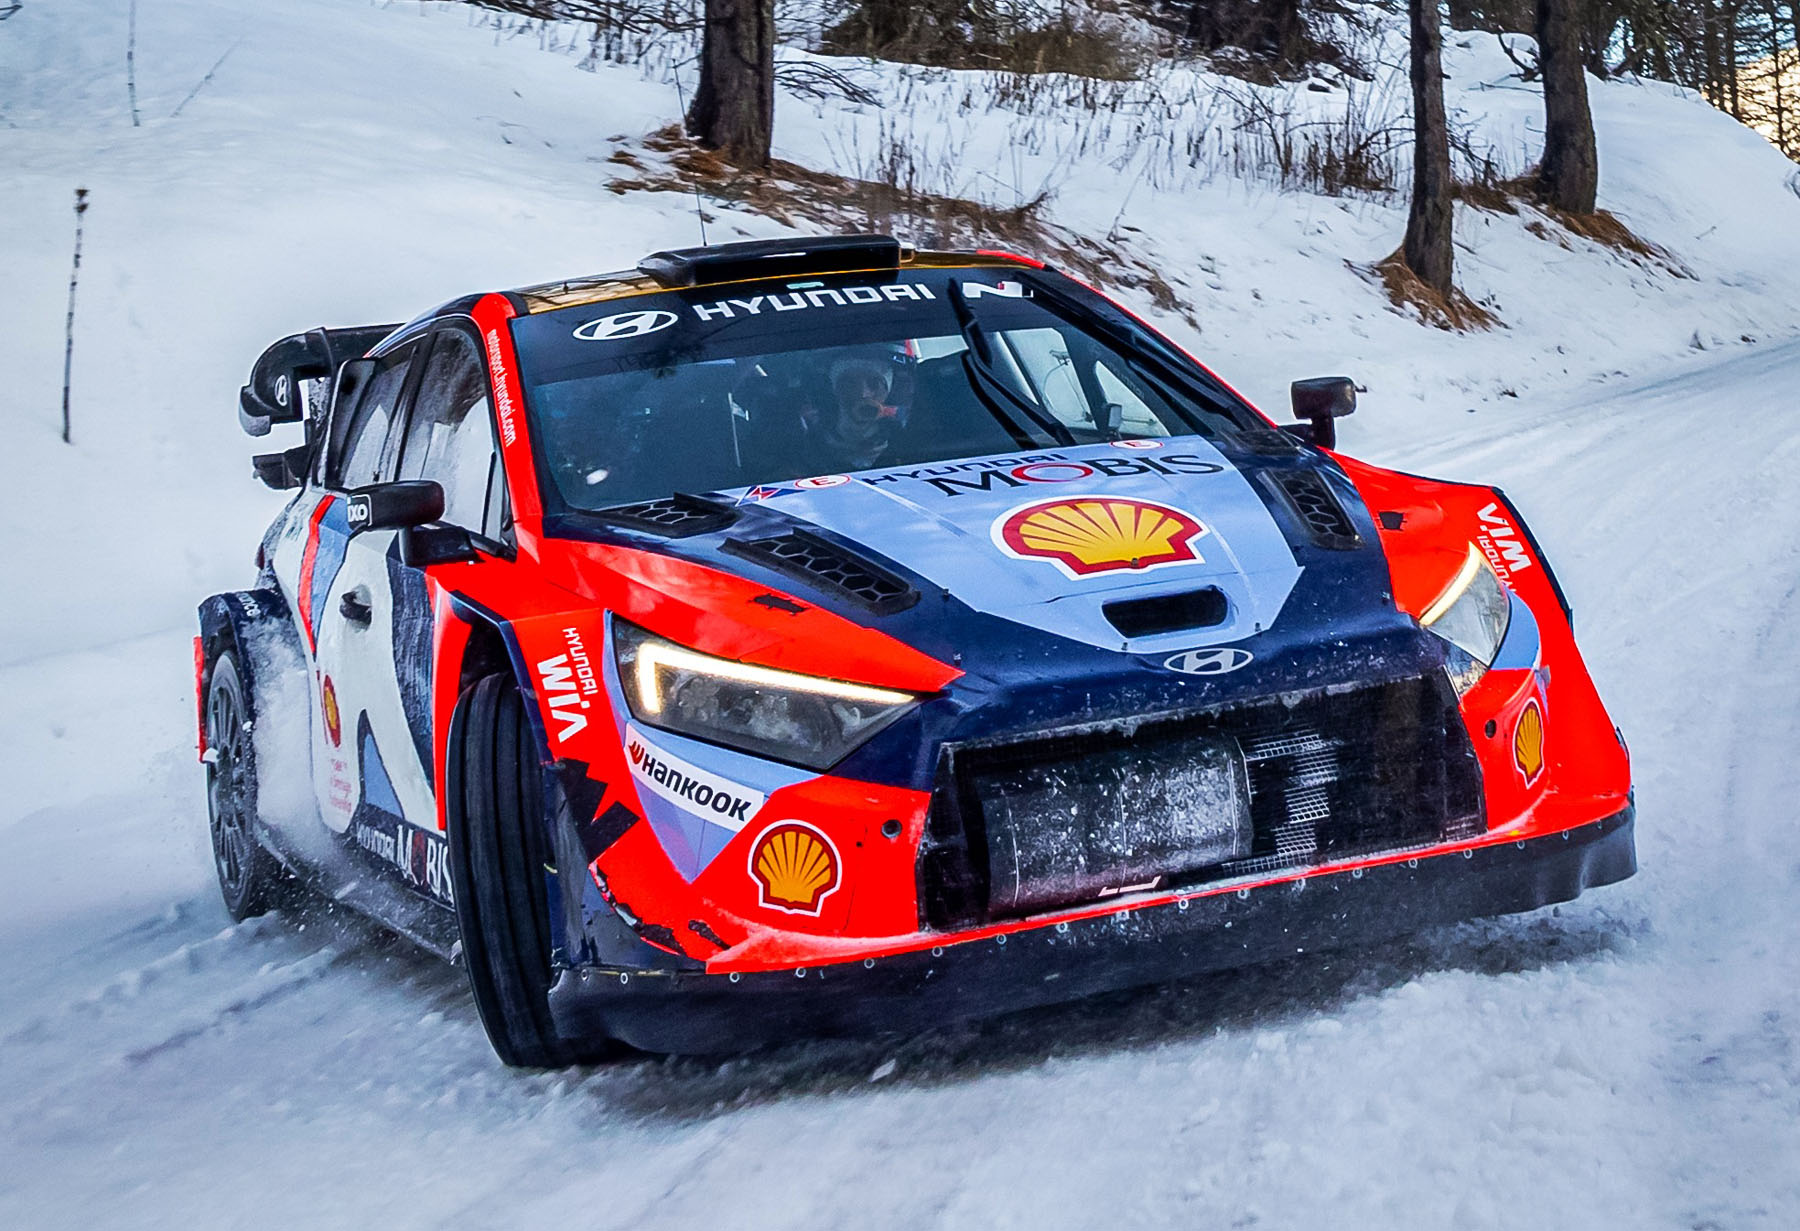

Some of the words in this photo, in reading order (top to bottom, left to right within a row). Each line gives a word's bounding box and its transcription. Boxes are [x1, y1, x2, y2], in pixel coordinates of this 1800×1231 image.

[692, 283, 937, 321] HYUNDAI
[861, 453, 1069, 486] HYUNDAI
[921, 454, 1225, 498] MOBIS
[1476, 535, 1518, 593] YUNDAI
[562, 627, 599, 695] HYUNDAI
